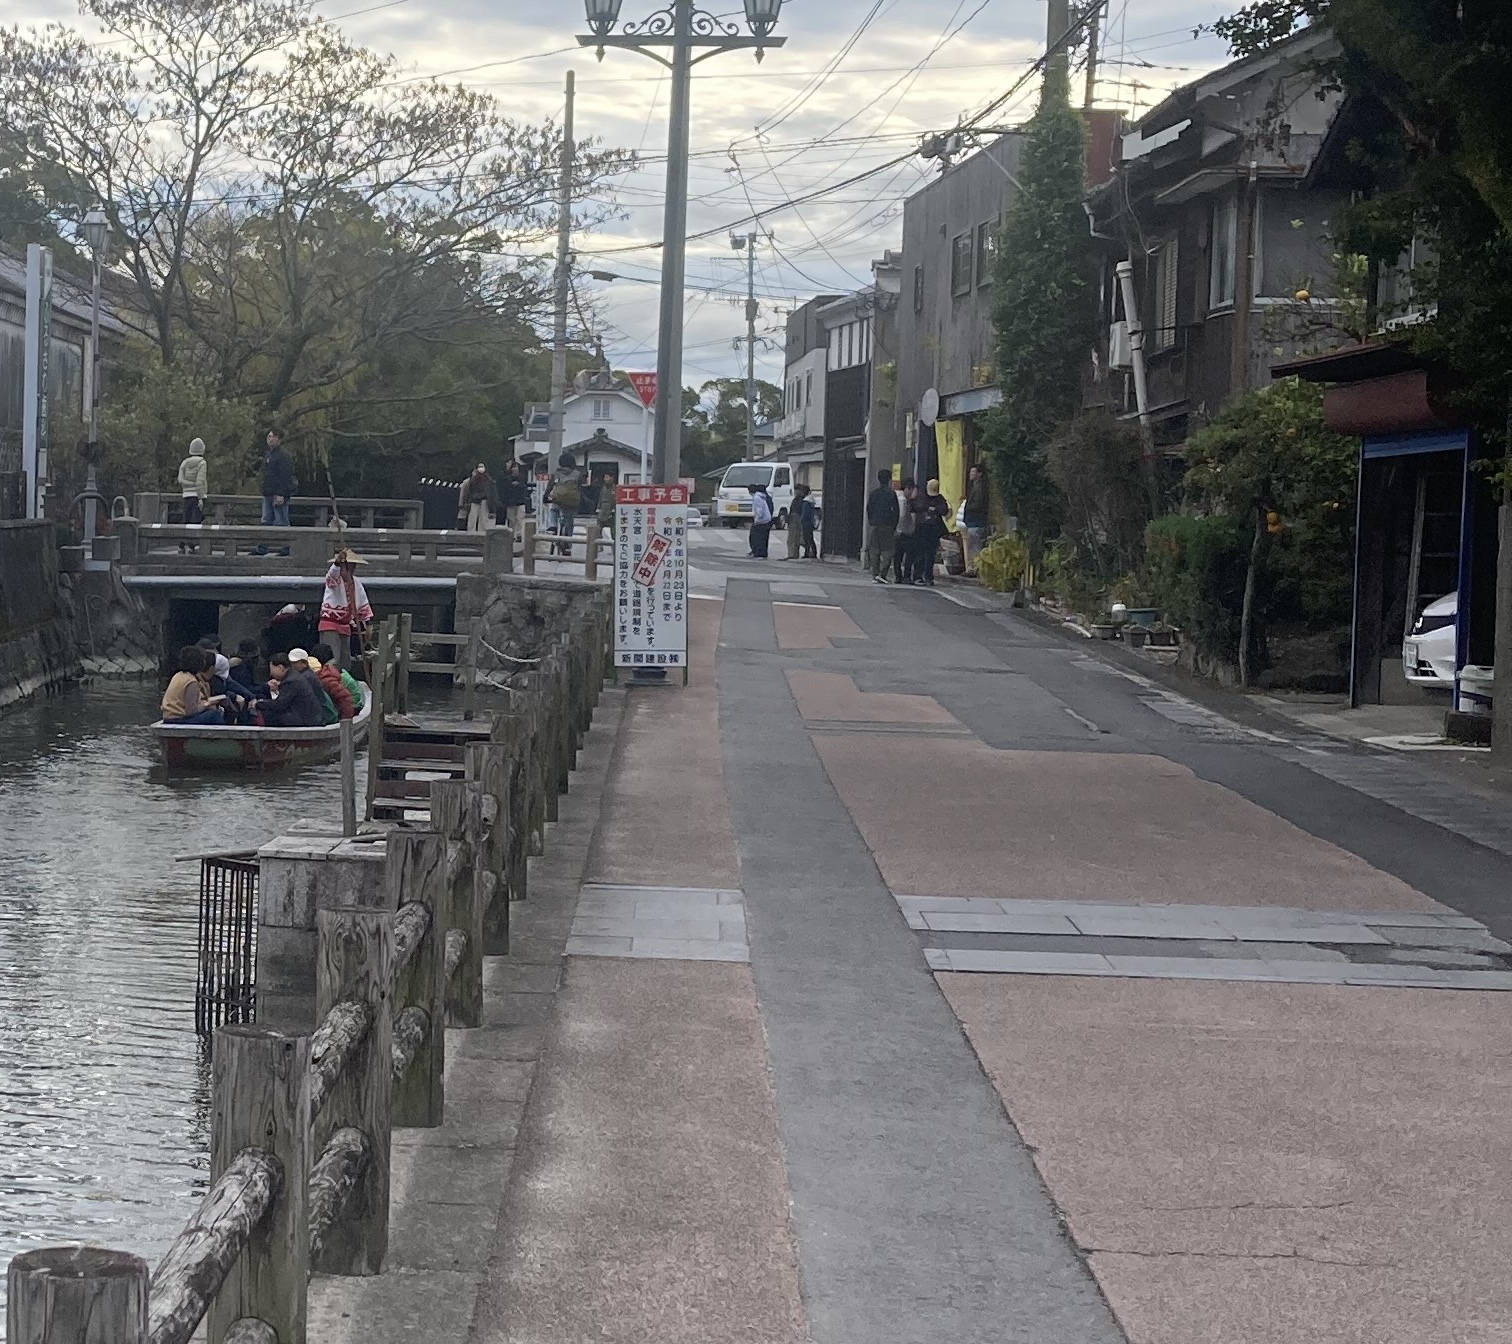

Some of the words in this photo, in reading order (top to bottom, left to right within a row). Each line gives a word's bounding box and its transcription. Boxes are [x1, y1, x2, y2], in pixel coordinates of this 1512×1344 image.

[621, 488, 683, 501] 工事予告
[673, 516, 684, 621] 令和5年10月23日より
